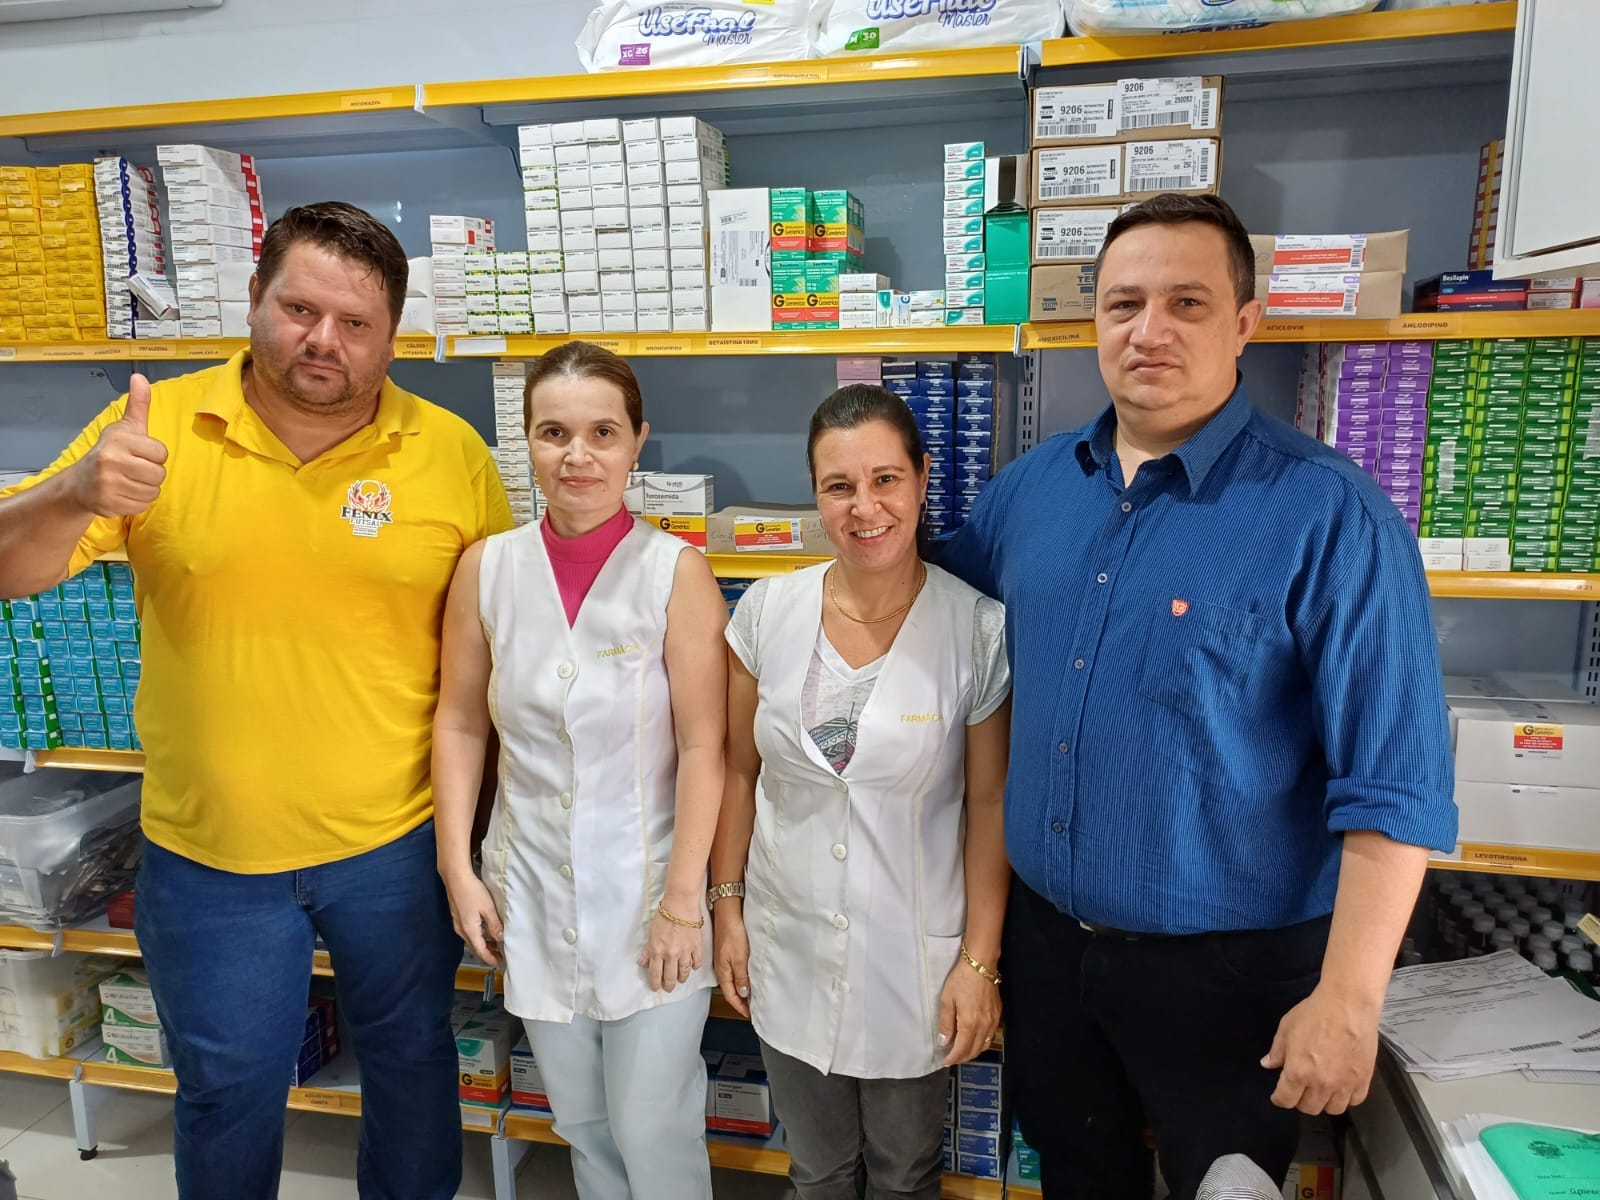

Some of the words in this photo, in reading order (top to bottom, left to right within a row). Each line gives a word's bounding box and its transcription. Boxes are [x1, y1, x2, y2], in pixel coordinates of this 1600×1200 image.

[938, 11, 992, 29] Master
[702, 30, 753, 47] Master
[862, 31, 877, 40] 30
[635, 46, 649, 55] 26
[1124, 82, 1144, 93] 9206
[1060, 104, 1083, 115] 9206
[1133, 145, 1154, 156] 9206
[1062, 165, 1086, 176] 9206
[772, 223, 784, 236] G
[1060, 227, 1083, 237] 9206
[774, 294, 785, 308] G
[806, 293, 818, 307] G
[341, 506, 392, 522] FENIX
[660, 518, 671, 531] G
[756, 522, 765, 533] G
[1523, 725, 1534, 735] G
[104, 1008, 117, 1024] 4
[106, 1047, 119, 1064] 4
[462, 1073, 473, 1086] G
